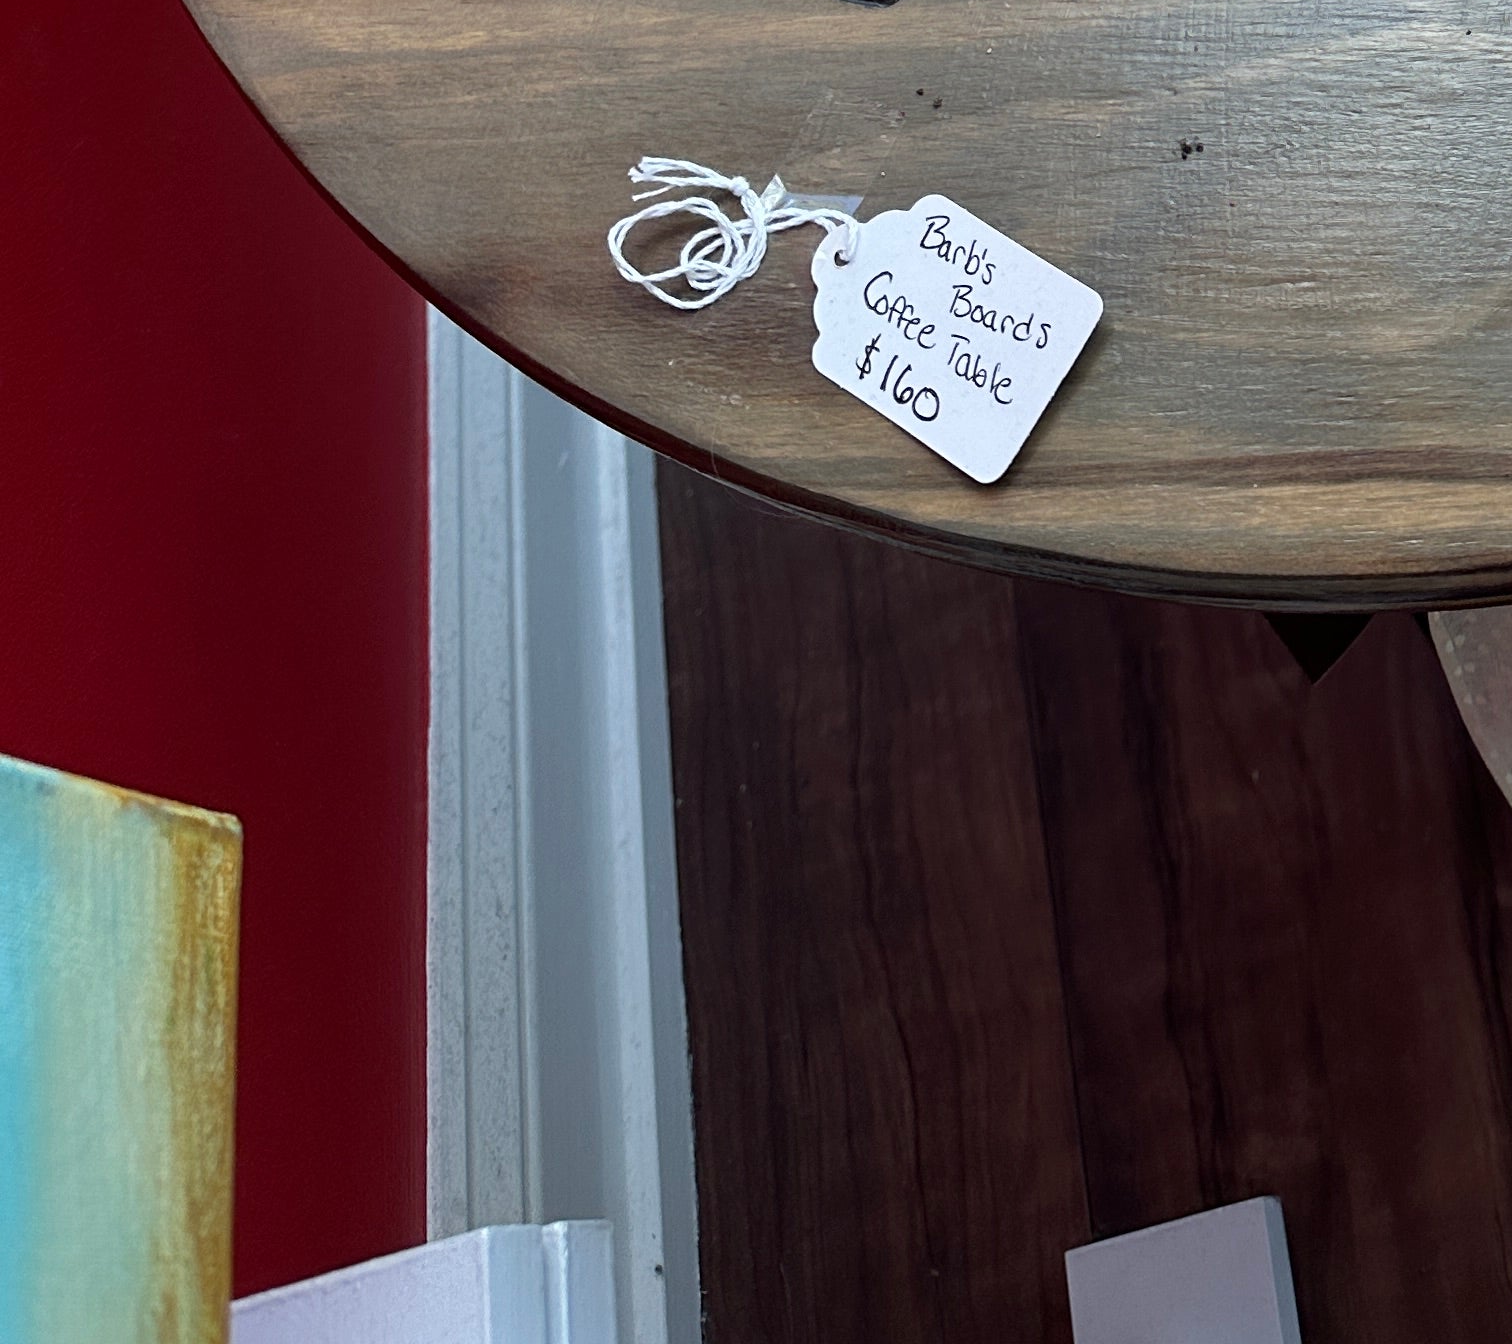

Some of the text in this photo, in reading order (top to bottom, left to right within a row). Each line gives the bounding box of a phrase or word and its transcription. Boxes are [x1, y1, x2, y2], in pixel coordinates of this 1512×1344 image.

[919, 215, 997, 285] Barb's
[863, 271, 1013, 405] Coffee Table
[949, 284, 1051, 349] Boards
[855, 333, 940, 422] $160
